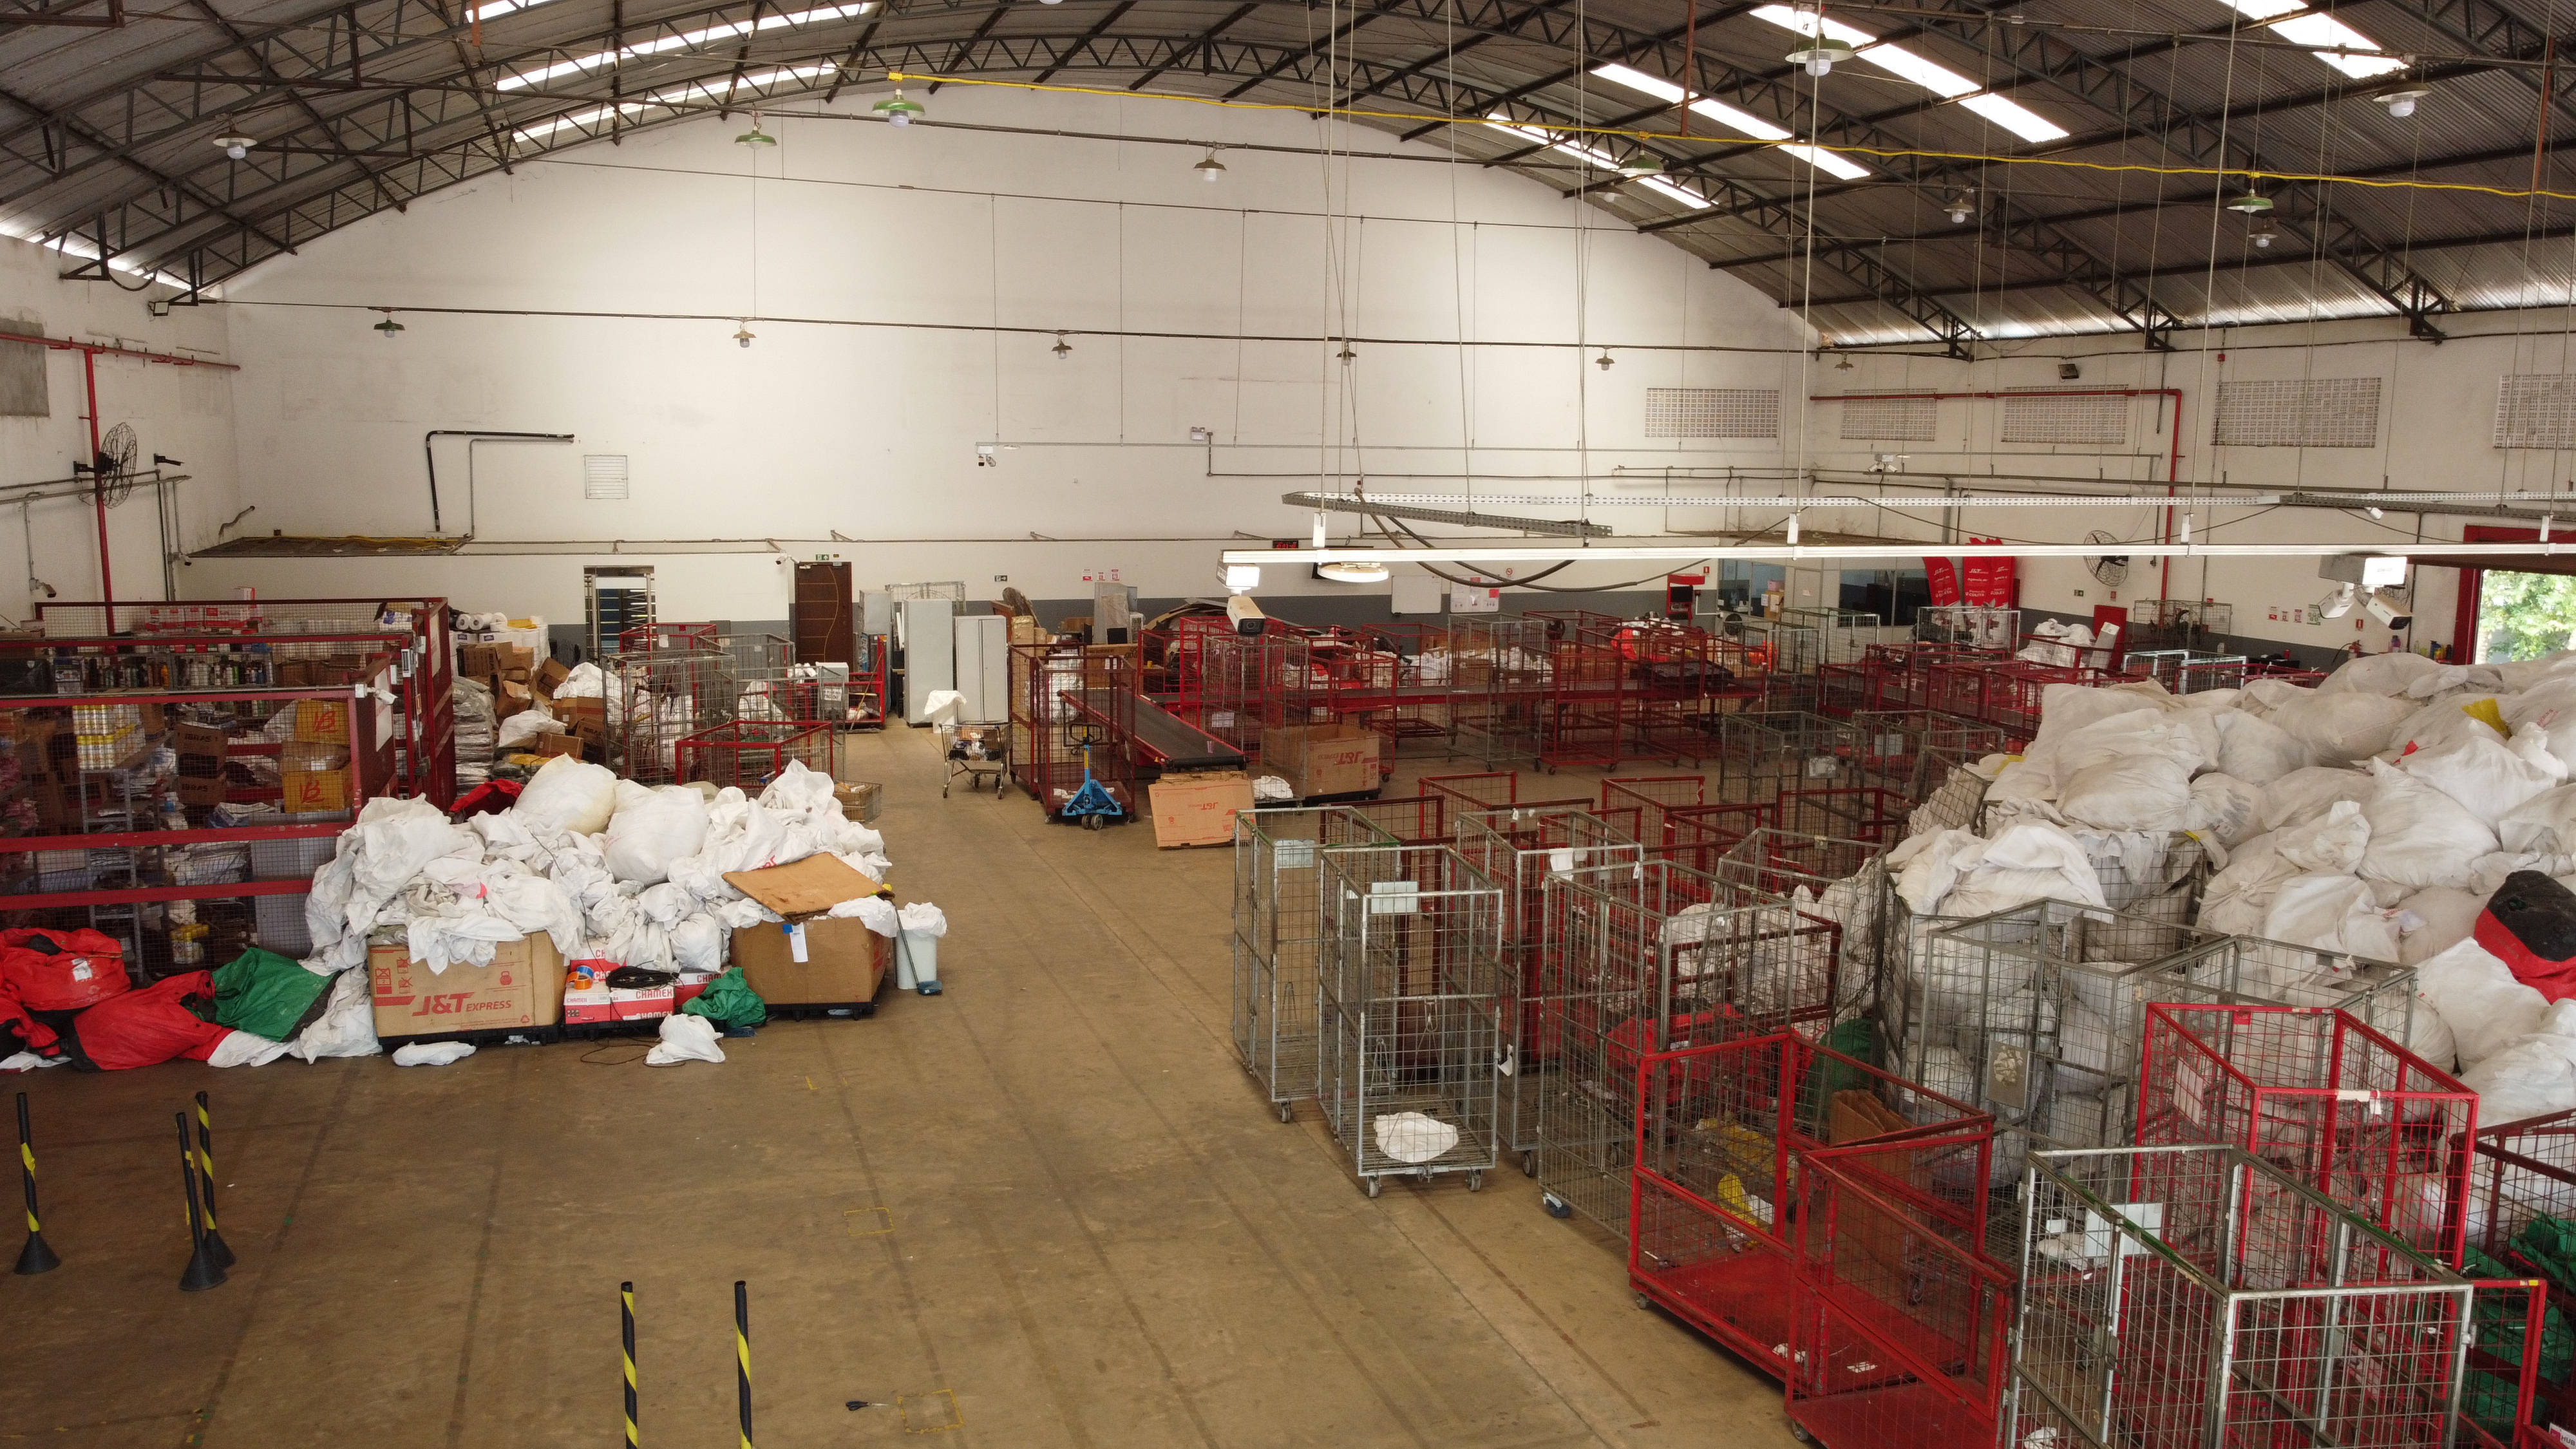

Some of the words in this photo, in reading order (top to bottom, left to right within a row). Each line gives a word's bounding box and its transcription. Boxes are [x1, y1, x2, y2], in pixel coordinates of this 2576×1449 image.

[1334, 751, 1364, 766] J&T
[696, 973, 725, 983] CHAM
[636, 988, 673, 999] CHAMEX
[412, 992, 475, 1017] J&T
[466, 999, 512, 1012] EXPRESS
